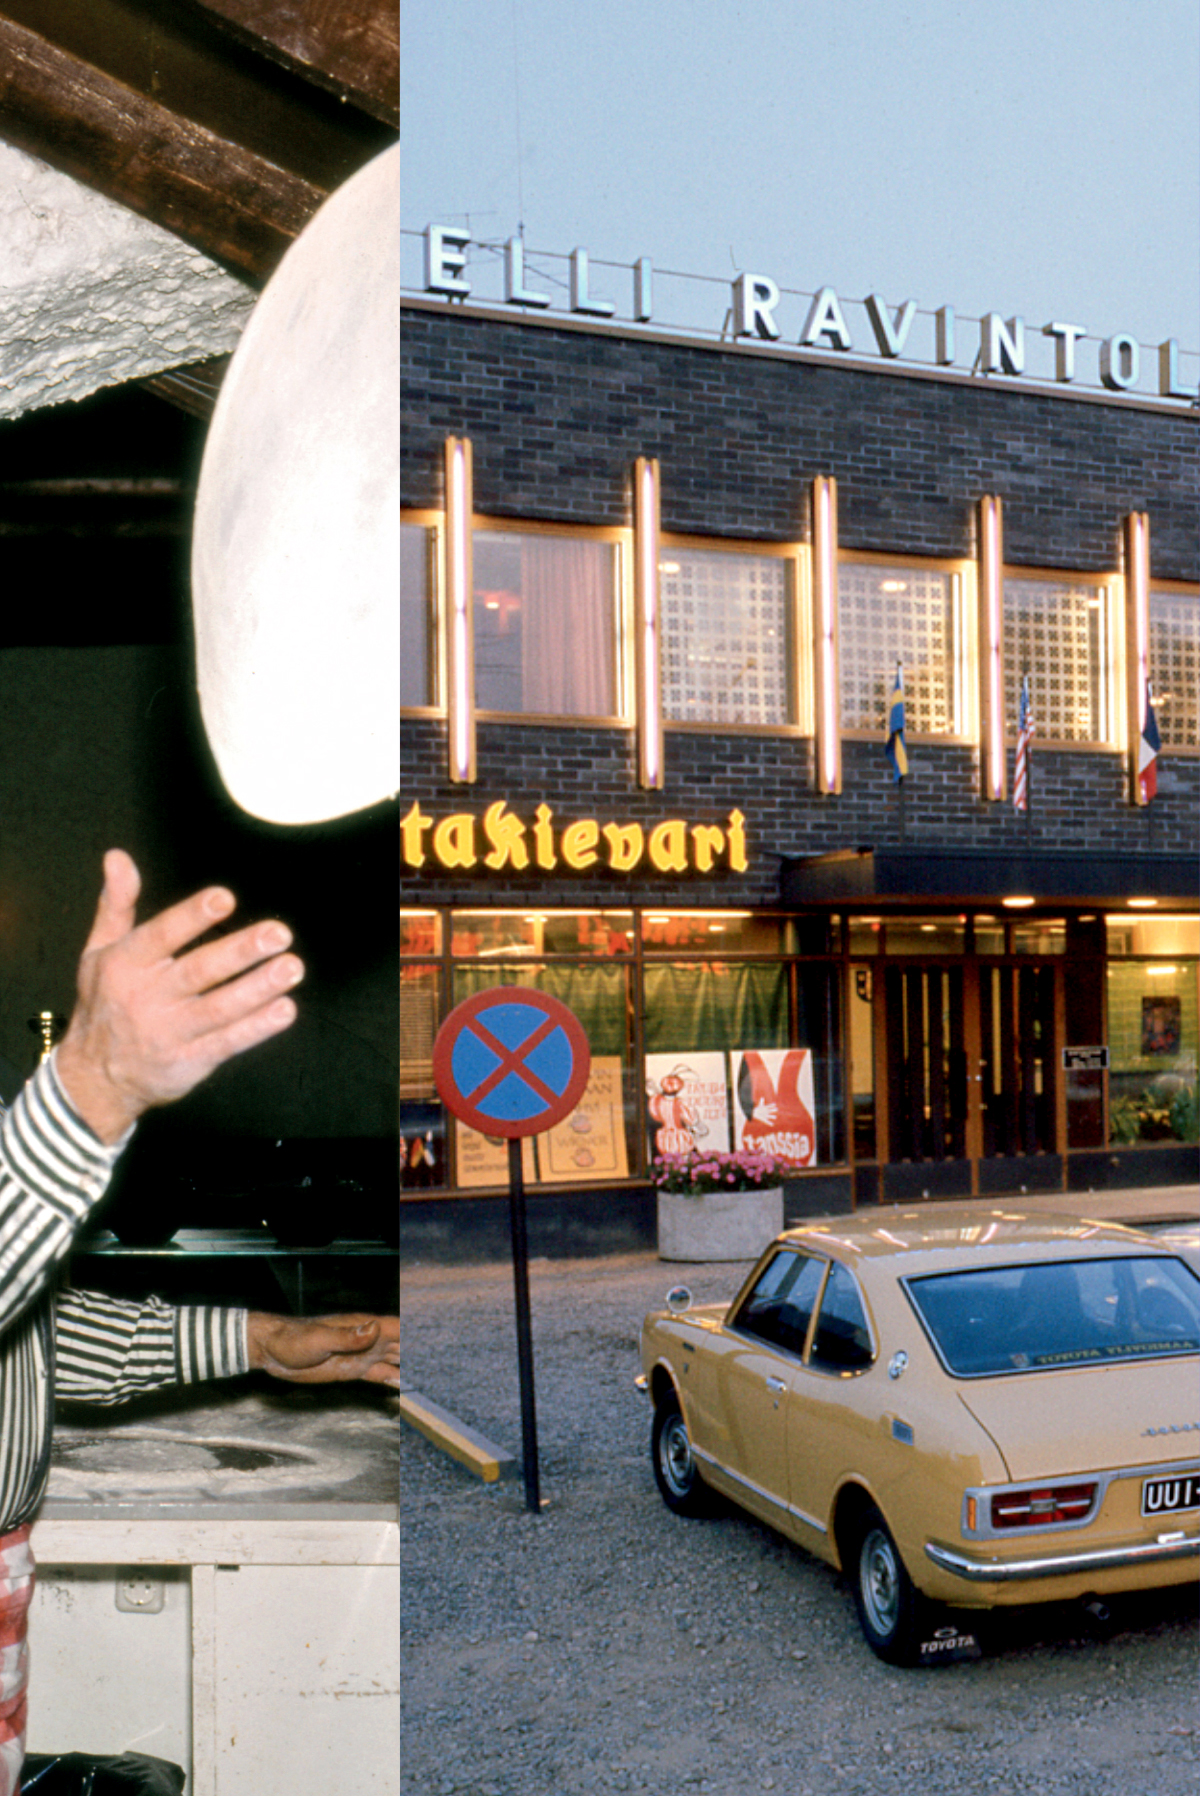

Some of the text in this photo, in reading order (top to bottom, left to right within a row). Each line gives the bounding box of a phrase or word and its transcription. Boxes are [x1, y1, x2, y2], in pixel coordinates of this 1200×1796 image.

[424, 223, 652, 322] ELLI
[400, 800, 749, 872] takievari
[920, 1635, 975, 1654] TOYOTA
